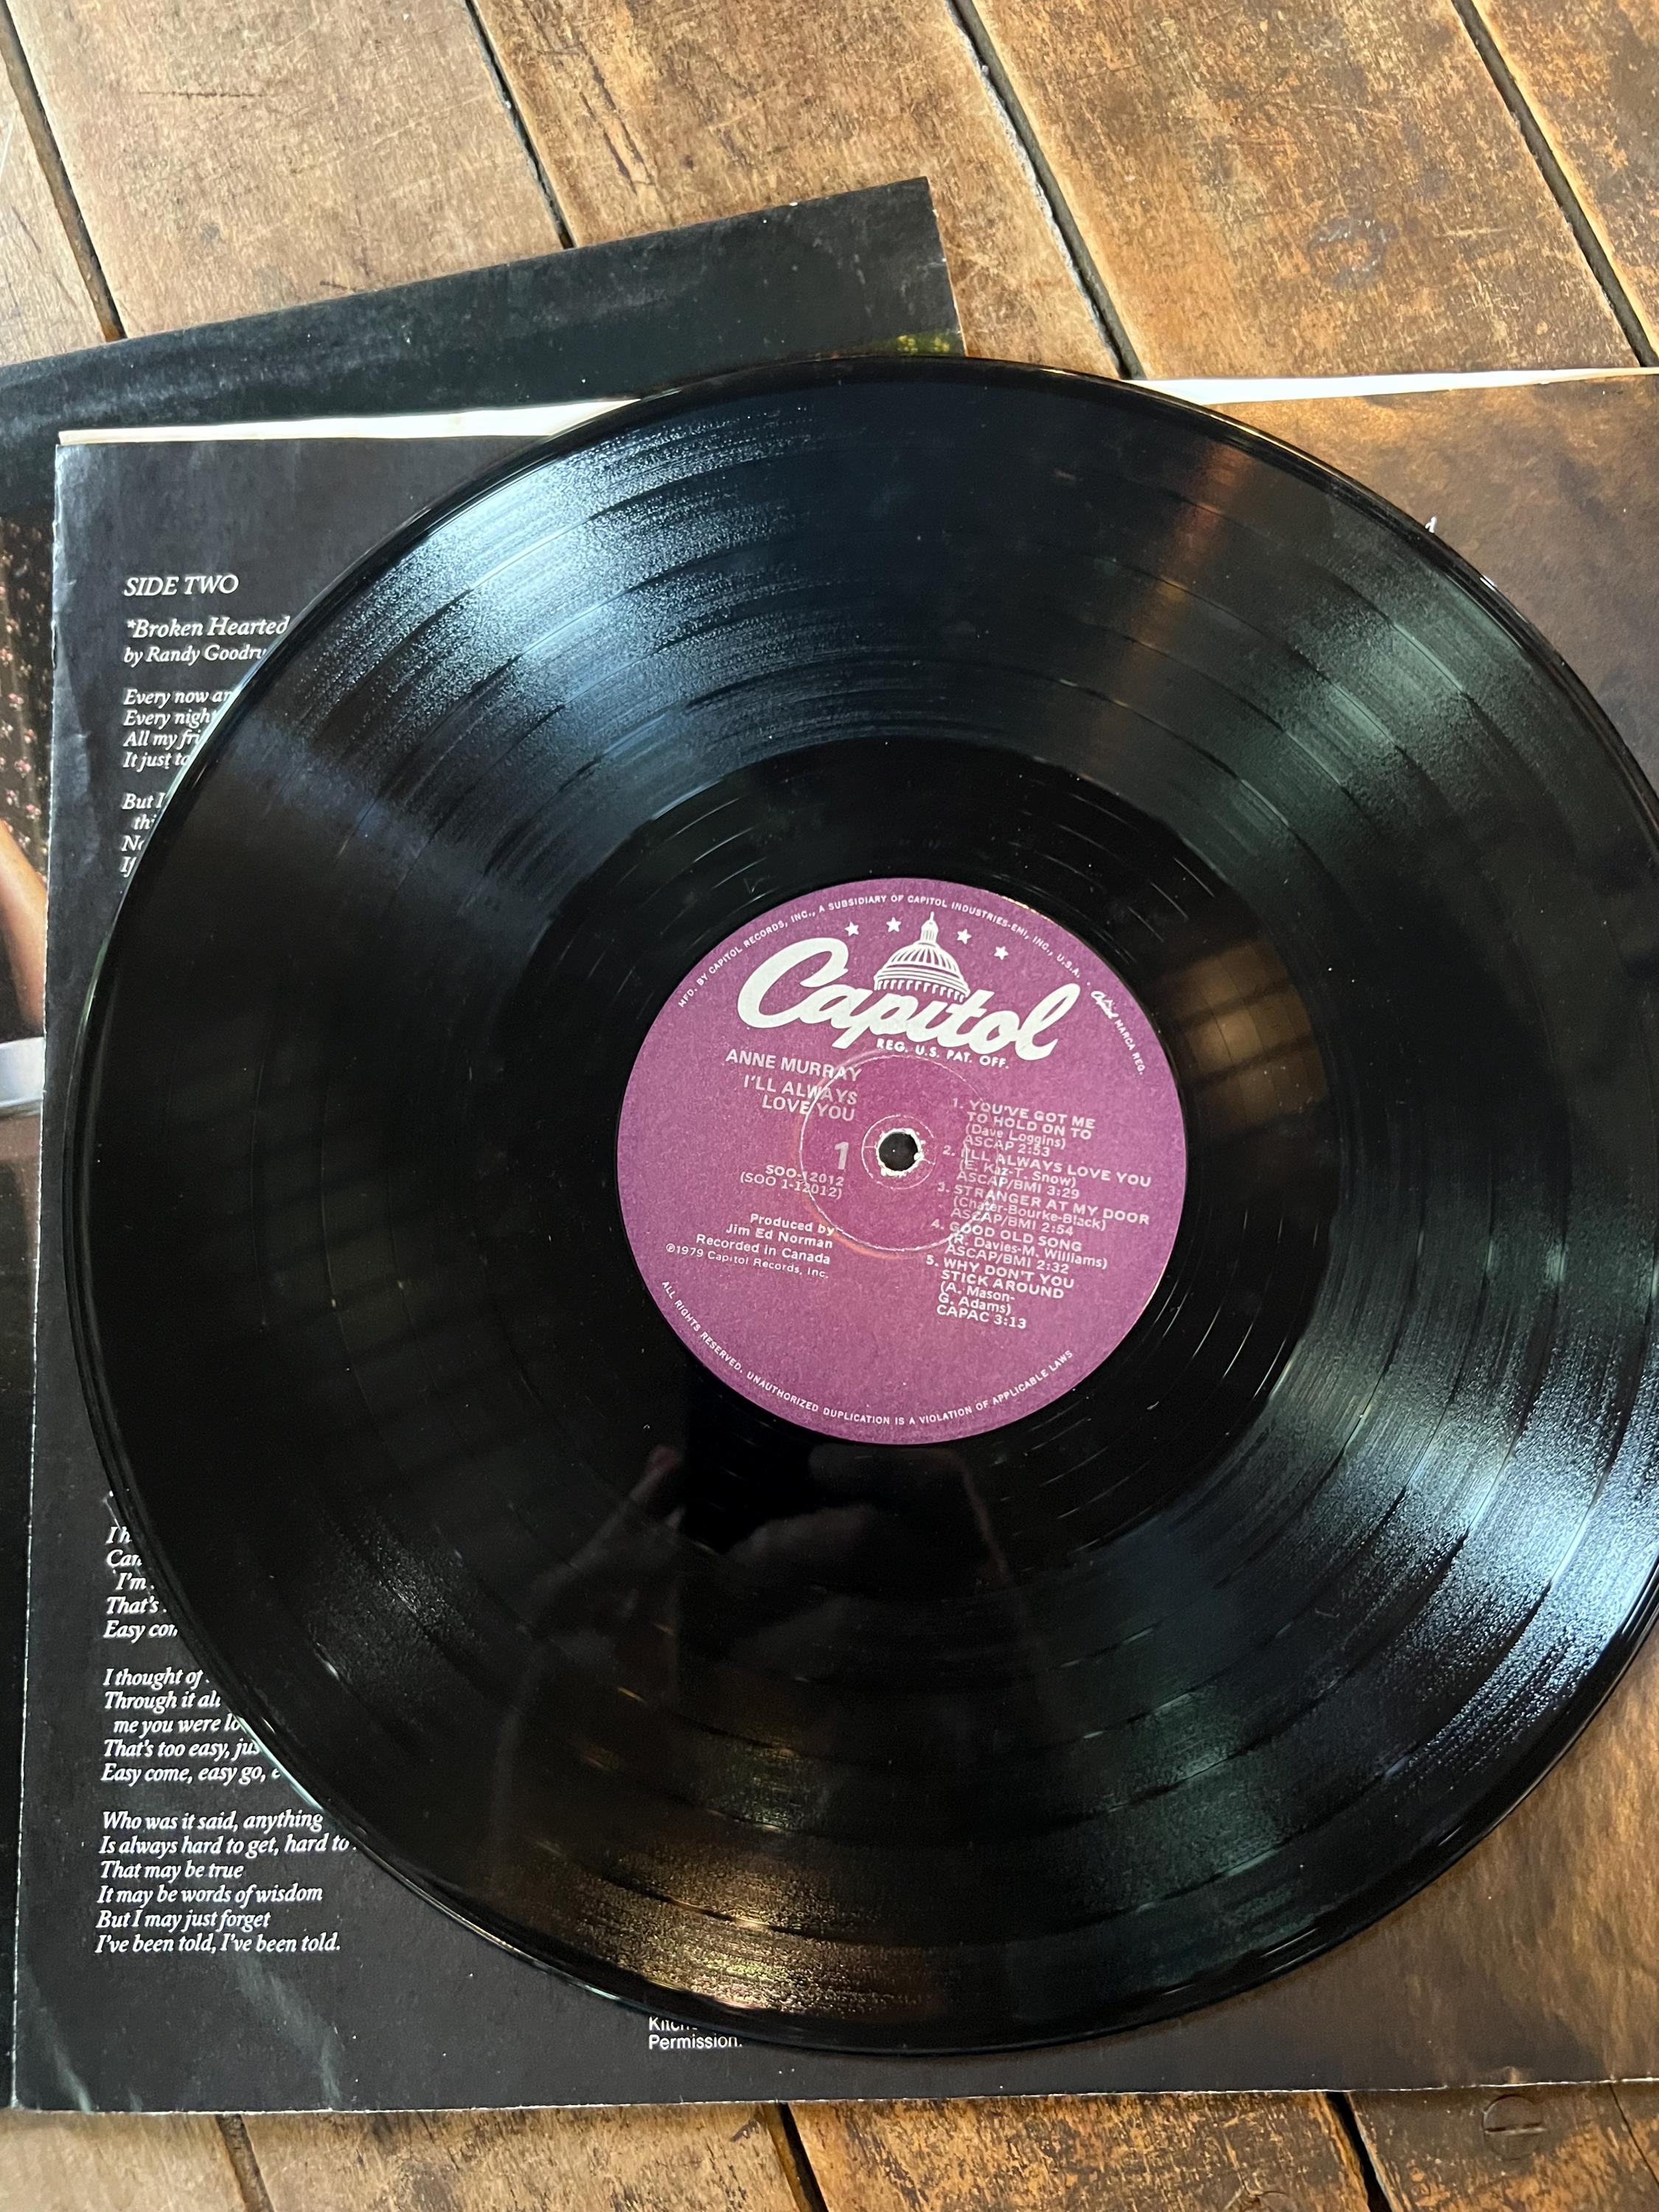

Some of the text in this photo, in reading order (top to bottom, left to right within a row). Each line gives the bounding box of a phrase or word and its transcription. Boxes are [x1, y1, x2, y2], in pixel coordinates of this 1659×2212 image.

[124, 574, 239, 597] SIDE TWO
[207, 615, 291, 636] Hearted
[123, 646, 200, 667] by Randy
[123, 689, 170, 709] Every
[175, 692, 209, 703] now
[123, 709, 170, 730] Every
[123, 731, 178, 751] All my
[123, 751, 171, 772] It just
[122, 792, 166, 810] But I
[678, 989, 697, 1007] MFD.
[696, 973, 708, 986] BY
[709, 947, 742, 974] CAPITOL
[743, 920, 788, 947] RECORDS,
[828, 894, 887, 911] SUBSIDIARY
[891, 894, 904, 902] OF
[908, 894, 947, 908] CAPITOL
[737, 937, 1081, 1060] Capitol
[1115, 1020, 1135, 1050] MARCA
[726, 1048, 862, 1082] ANNE MURRAY
[876, 1038, 1009, 1069] REG. U.S. PAT. OFF.
[743, 1074, 858, 1105] I'LL ALWAYS
[762, 1095, 855, 1121] LOVE YOU
[953, 1097, 1096, 1129] 1. YOU'VE GOT ME
[966, 1122, 1066, 1150] (Dave Loggins)
[967, 1111, 1092, 1140] TO HOLD ON TO
[835, 1141, 849, 1170] 1
[963, 1135, 1050, 1158] ASCAP 2:53
[942, 1144, 1151, 1187] 2. ALWAYS LOVE YOU
[740, 1172, 776, 1186] (SOO
[956, 1171, 1079, 1199] ASCAP/BMI 3:29
[1032, 1171, 1077, 1189] Snow)
[954, 1184, 1150, 1225] STRANGER AT MY DOOR
[750, 1213, 835, 1237] Produced by
[950, 1208, 1074, 1236] ASCAP/BMI 2:54
[726, 1224, 832, 1249] Jim Ed Norman
[950, 1222, 1082, 1252] GOOD OLD SONG
[696, 1234, 830, 1265] Recorded Canada
[945, 1244, 1069, 1274] ASCAP/BMI 2:32
[1044, 1248, 1107, 1270] Williams)
[707, 1251, 803, 1276] Capitol Records,
[926, 1255, 1074, 1289] 5. WHY DON'T YOU
[941, 1270, 1065, 1299] STICK AROUND
[967, 1286, 1015, 1302] Mason-
[938, 1293, 1012, 1315] G. Adams)
[936, 1305, 1026, 1329] CAPAC 3:13
[662, 1281, 675, 1299] ALL
[675, 1300, 701, 1332] RIGHTS
[700, 1332, 743, 1373] RESERVED.
[747, 1371, 819, 1412] UNAUTHORIZED
[823, 1408, 890, 1425] DUPLICATION
[919, 1405, 973, 1425] VIOLATION
[975, 1400, 989, 1411] OF
[992, 1368, 1048, 1405] APPLICABLE
[1048, 1349, 1074, 1371] LAWS
[106, 1526, 118, 1544] I
[116, 1573, 147, 1590] I'm
[106, 1596, 159, 1615] That's
[103, 1620, 145, 1644] Easy
[103, 1667, 184, 1691] I thought
[105, 1691, 195, 1714] Through it
[114, 1719, 221, 1739] me you were
[104, 1739, 230, 1761] That's too easy,
[101, 1763, 141, 1787] Easy
[145, 1768, 193, 1784] come,
[198, 1767, 237, 1786] easy
[238, 1767, 265, 1785] go,
[102, 1809, 323, 1834] Who was it said, anything
[99, 1834, 349, 1859] Is always hard to get, hard to
[100, 1860, 243, 1883] That may be true
[97, 1884, 322, 1908] It may be words of wisdom
[96, 1910, 271, 1932] But I may just forget
[94, 1933, 341, 1953] I've been told, I've been told.
[649, 2034, 742, 2049] Permission.
